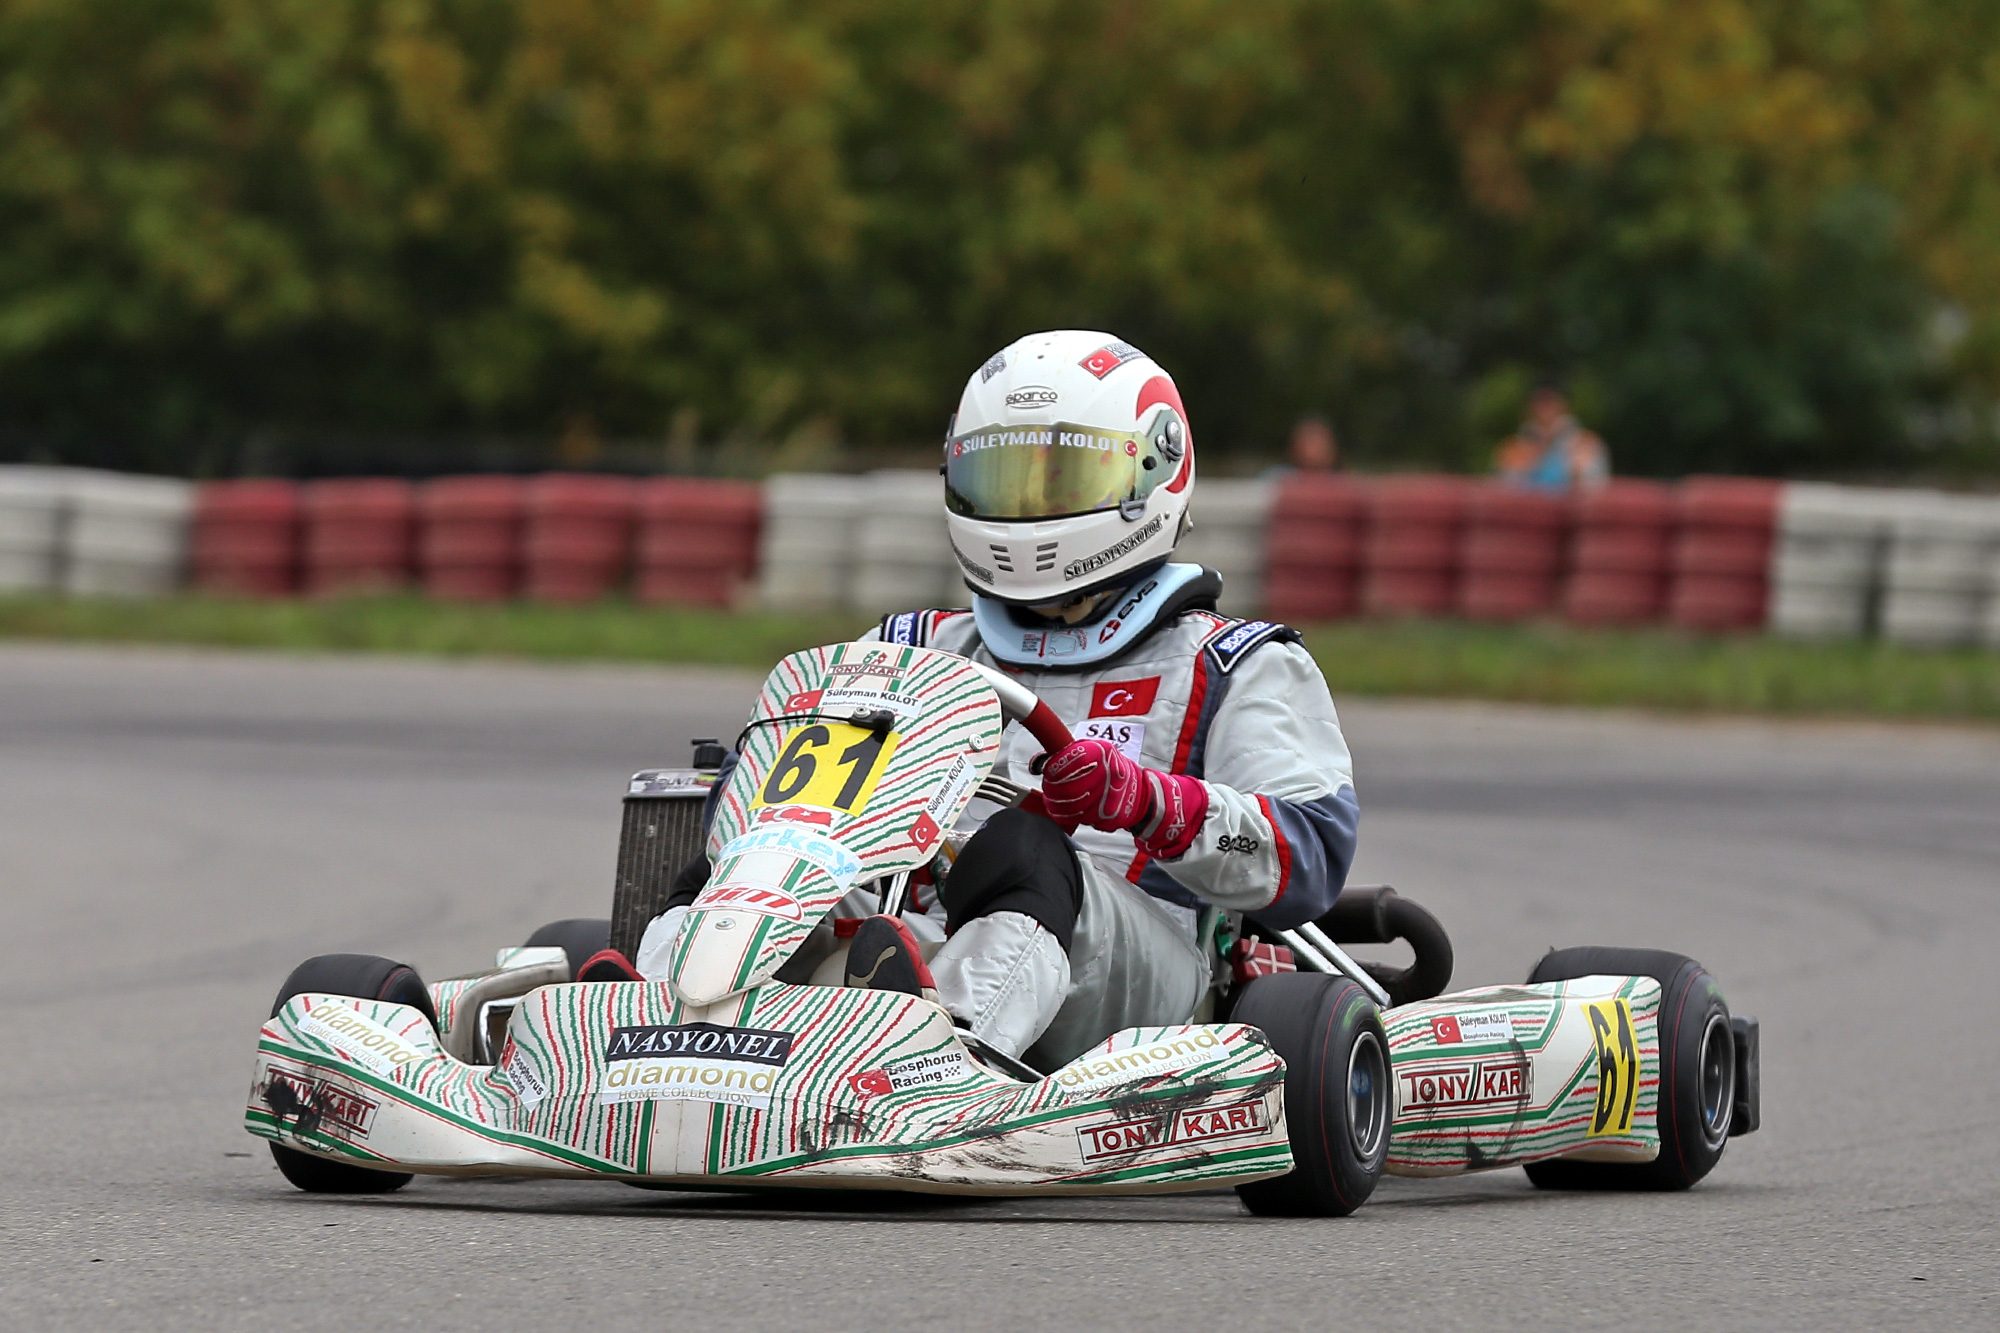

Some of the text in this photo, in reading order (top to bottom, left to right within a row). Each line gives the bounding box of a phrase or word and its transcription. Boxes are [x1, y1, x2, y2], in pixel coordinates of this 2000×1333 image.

[1005, 390, 1059, 405] sparco
[962, 431, 1120, 455] SÜLEYMAN KOLOT
[1118, 580, 1159, 619] EVS
[1218, 621, 1271, 653] sparco
[831, 665, 902, 678] TONY KART
[826, 688, 919, 708] Süleyman KOLOT
[1086, 723, 1132, 744] SAS
[763, 725, 890, 811] 61
[947, 755, 967, 784] KOLOT
[777, 845, 827, 867] potential
[304, 1022, 384, 1068] HOME COLLECTION
[309, 1004, 423, 1064] diamond
[610, 1030, 786, 1060] NASYONEL
[1059, 1028, 1220, 1087] diamond
[1084, 1051, 1214, 1093] HOME COLLECTION
[1588, 1001, 1636, 1134] 61
[607, 1061, 777, 1092] diamond
[891, 1071, 943, 1090] Racing
[1401, 1062, 1531, 1103] TONY KART
[617, 1086, 752, 1105] HOME COLLECTION
[1081, 1101, 1263, 1153] TONY KART
